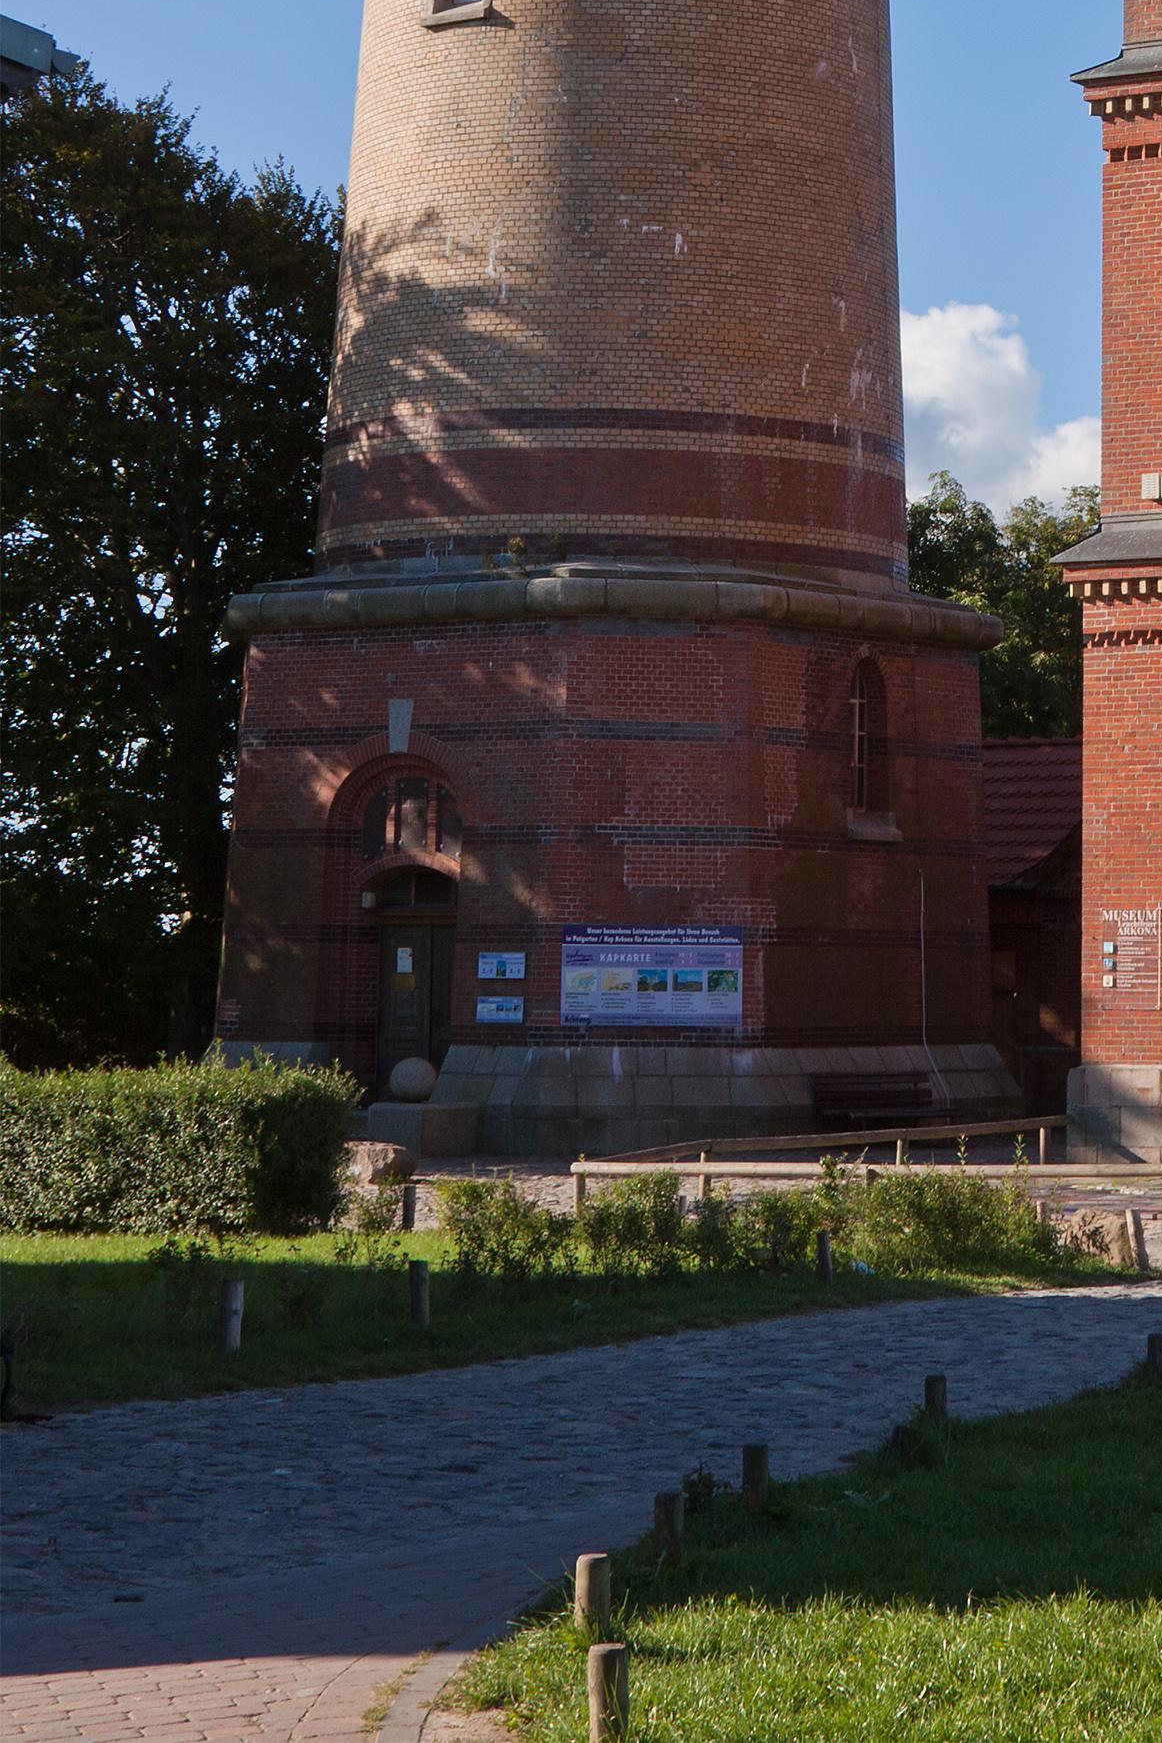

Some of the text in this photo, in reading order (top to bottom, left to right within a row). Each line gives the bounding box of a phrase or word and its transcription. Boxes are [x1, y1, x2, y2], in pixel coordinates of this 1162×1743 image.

[1102, 910, 1157, 921] MUSEUM
[1117, 927, 1157, 935] ARKONA
[572, 935, 598, 943] Putgarten
[600, 953, 651, 962] KAPKARTE
